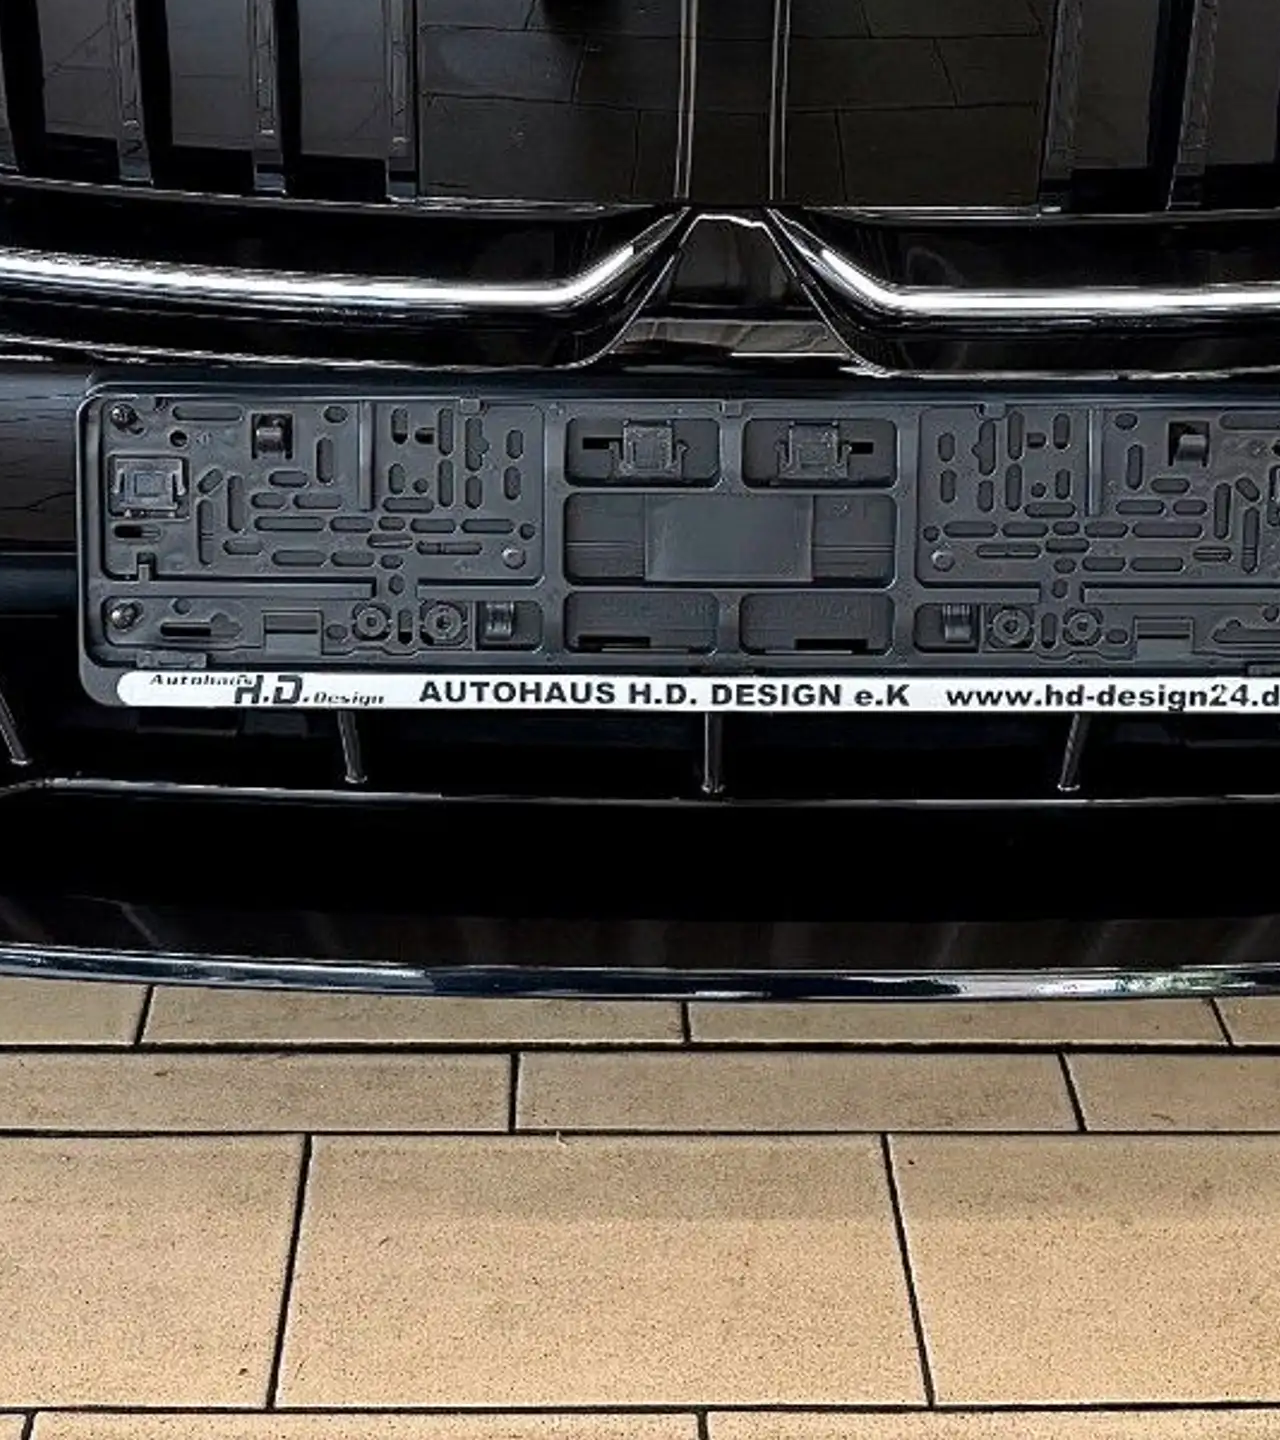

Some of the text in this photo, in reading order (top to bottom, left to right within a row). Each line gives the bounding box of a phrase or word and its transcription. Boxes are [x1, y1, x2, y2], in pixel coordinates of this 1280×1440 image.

[418, 681, 616, 706] AUTOHAUS
[628, 682, 698, 706] H.D.
[711, 683, 841, 707] DESIGN
[854, 684, 910, 707] e.K
